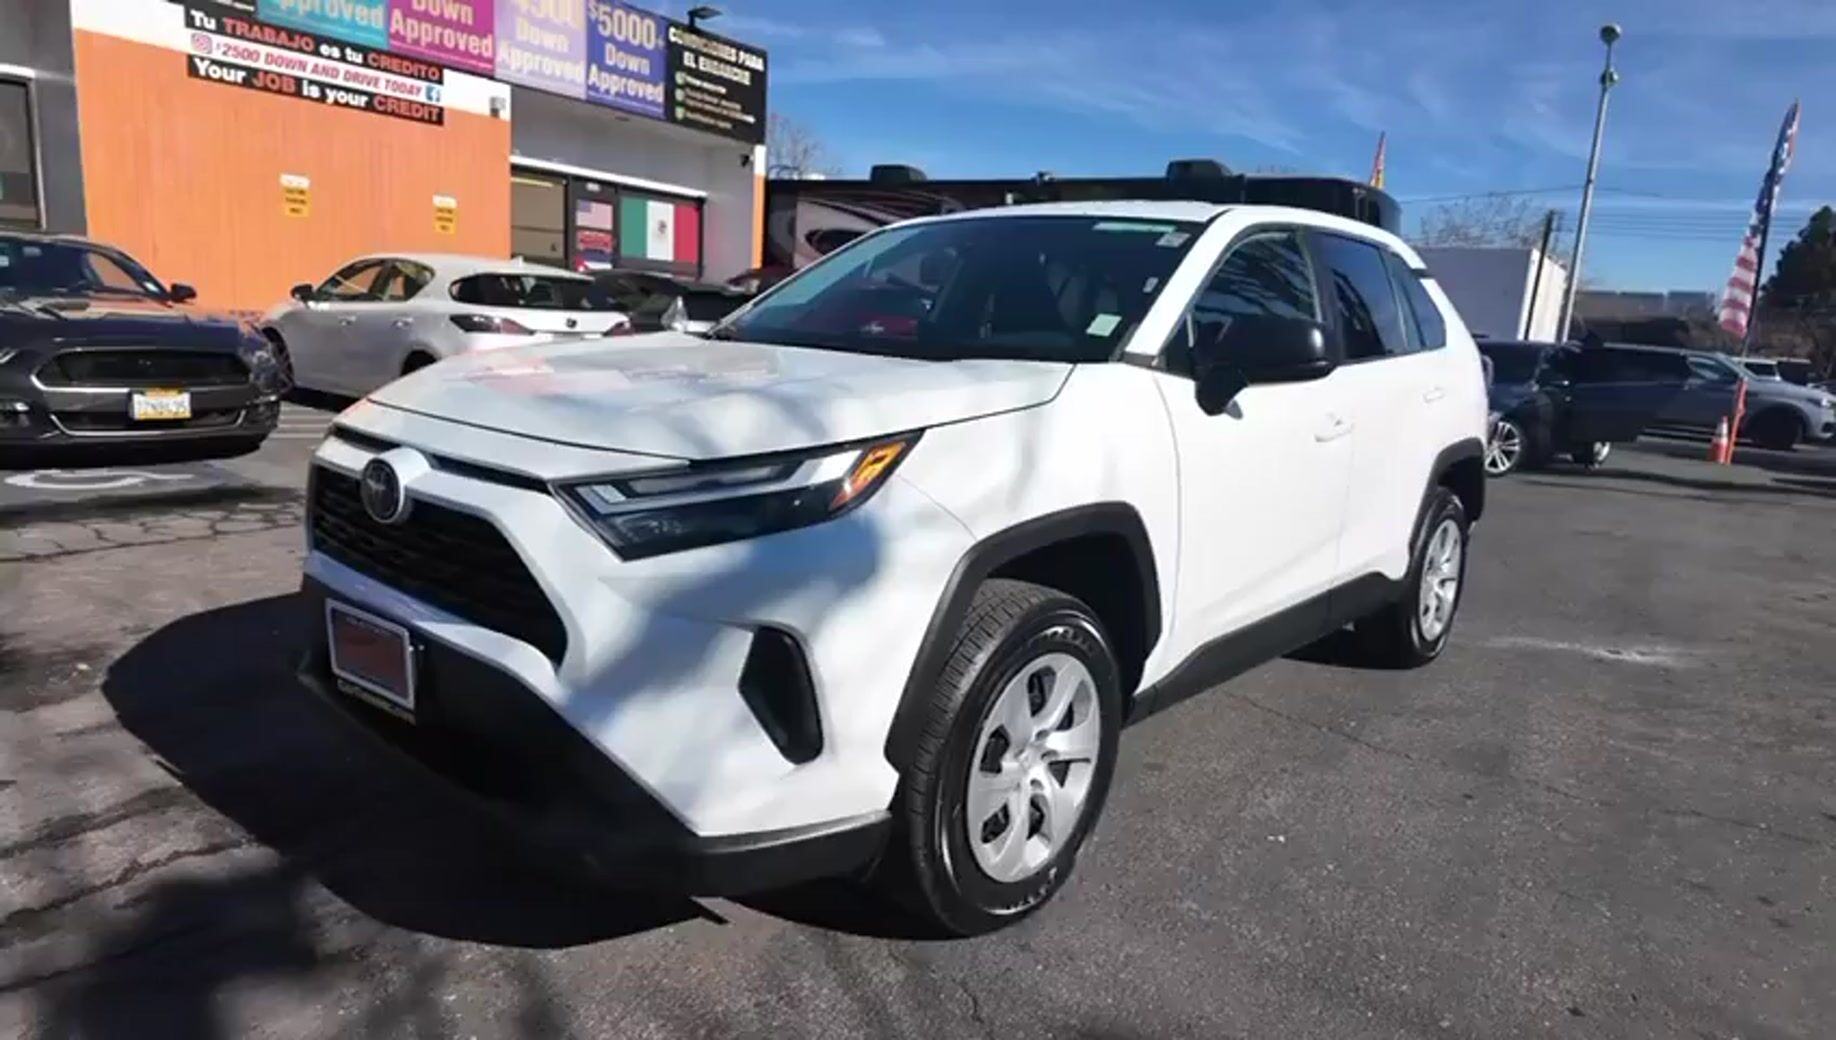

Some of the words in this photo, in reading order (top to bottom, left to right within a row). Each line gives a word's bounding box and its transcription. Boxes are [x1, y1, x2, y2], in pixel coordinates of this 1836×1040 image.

[190, 9, 216, 30] Tu
[223, 17, 315, 52] TRABAJO
[319, 43, 341, 59] es
[345, 47, 363, 64] tu
[367, 52, 440, 81] CREDITO
[391, 8, 493, 57] Approved
[264, 52, 307, 73] DOWN
[310, 63, 340, 79] AND
[343, 72, 383, 90] DRIVE
[384, 79, 423, 97] TODAY
[500, 40, 586, 84] Approved
[604, 42, 650, 75] Down
[193, 57, 247, 84] Your
[251, 71, 296, 94] JOB
[325, 86, 369, 107] your
[373, 95, 440, 122] CREDIT
[588, 63, 663, 103] Approved
